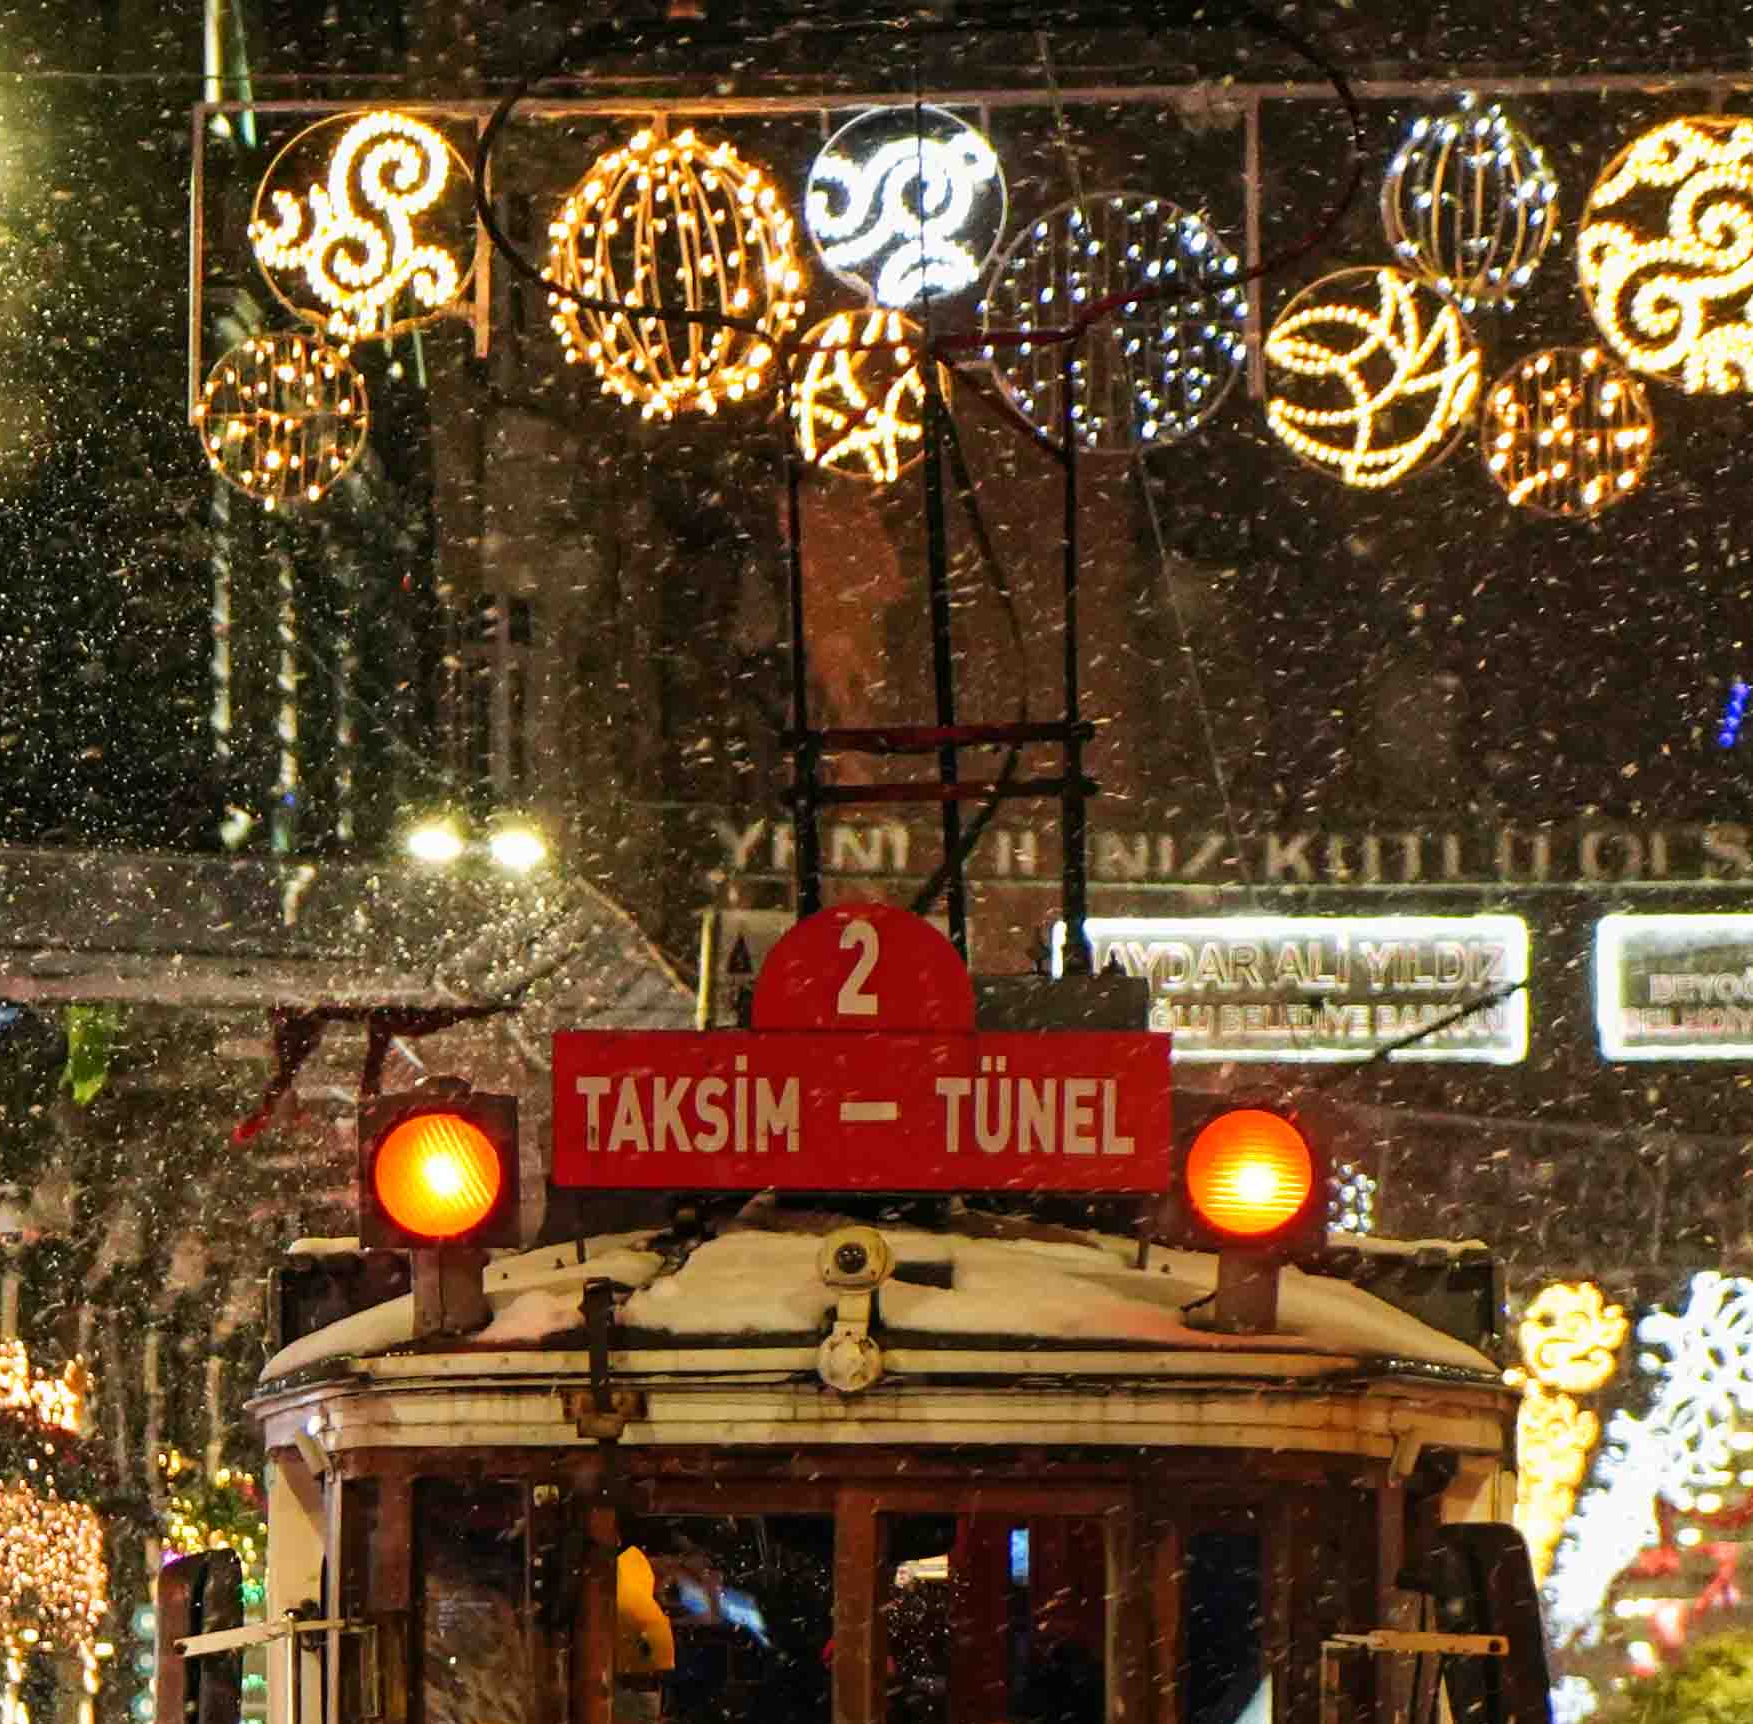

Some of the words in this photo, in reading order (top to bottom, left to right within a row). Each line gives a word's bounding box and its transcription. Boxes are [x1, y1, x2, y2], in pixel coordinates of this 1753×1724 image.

[837, 919, 880, 1016] 2
[1359, 941, 1506, 988] YILDIZ
[577, 1055, 800, 1153] TAKSİM
[936, 1055, 1135, 1155] TÜNEL
